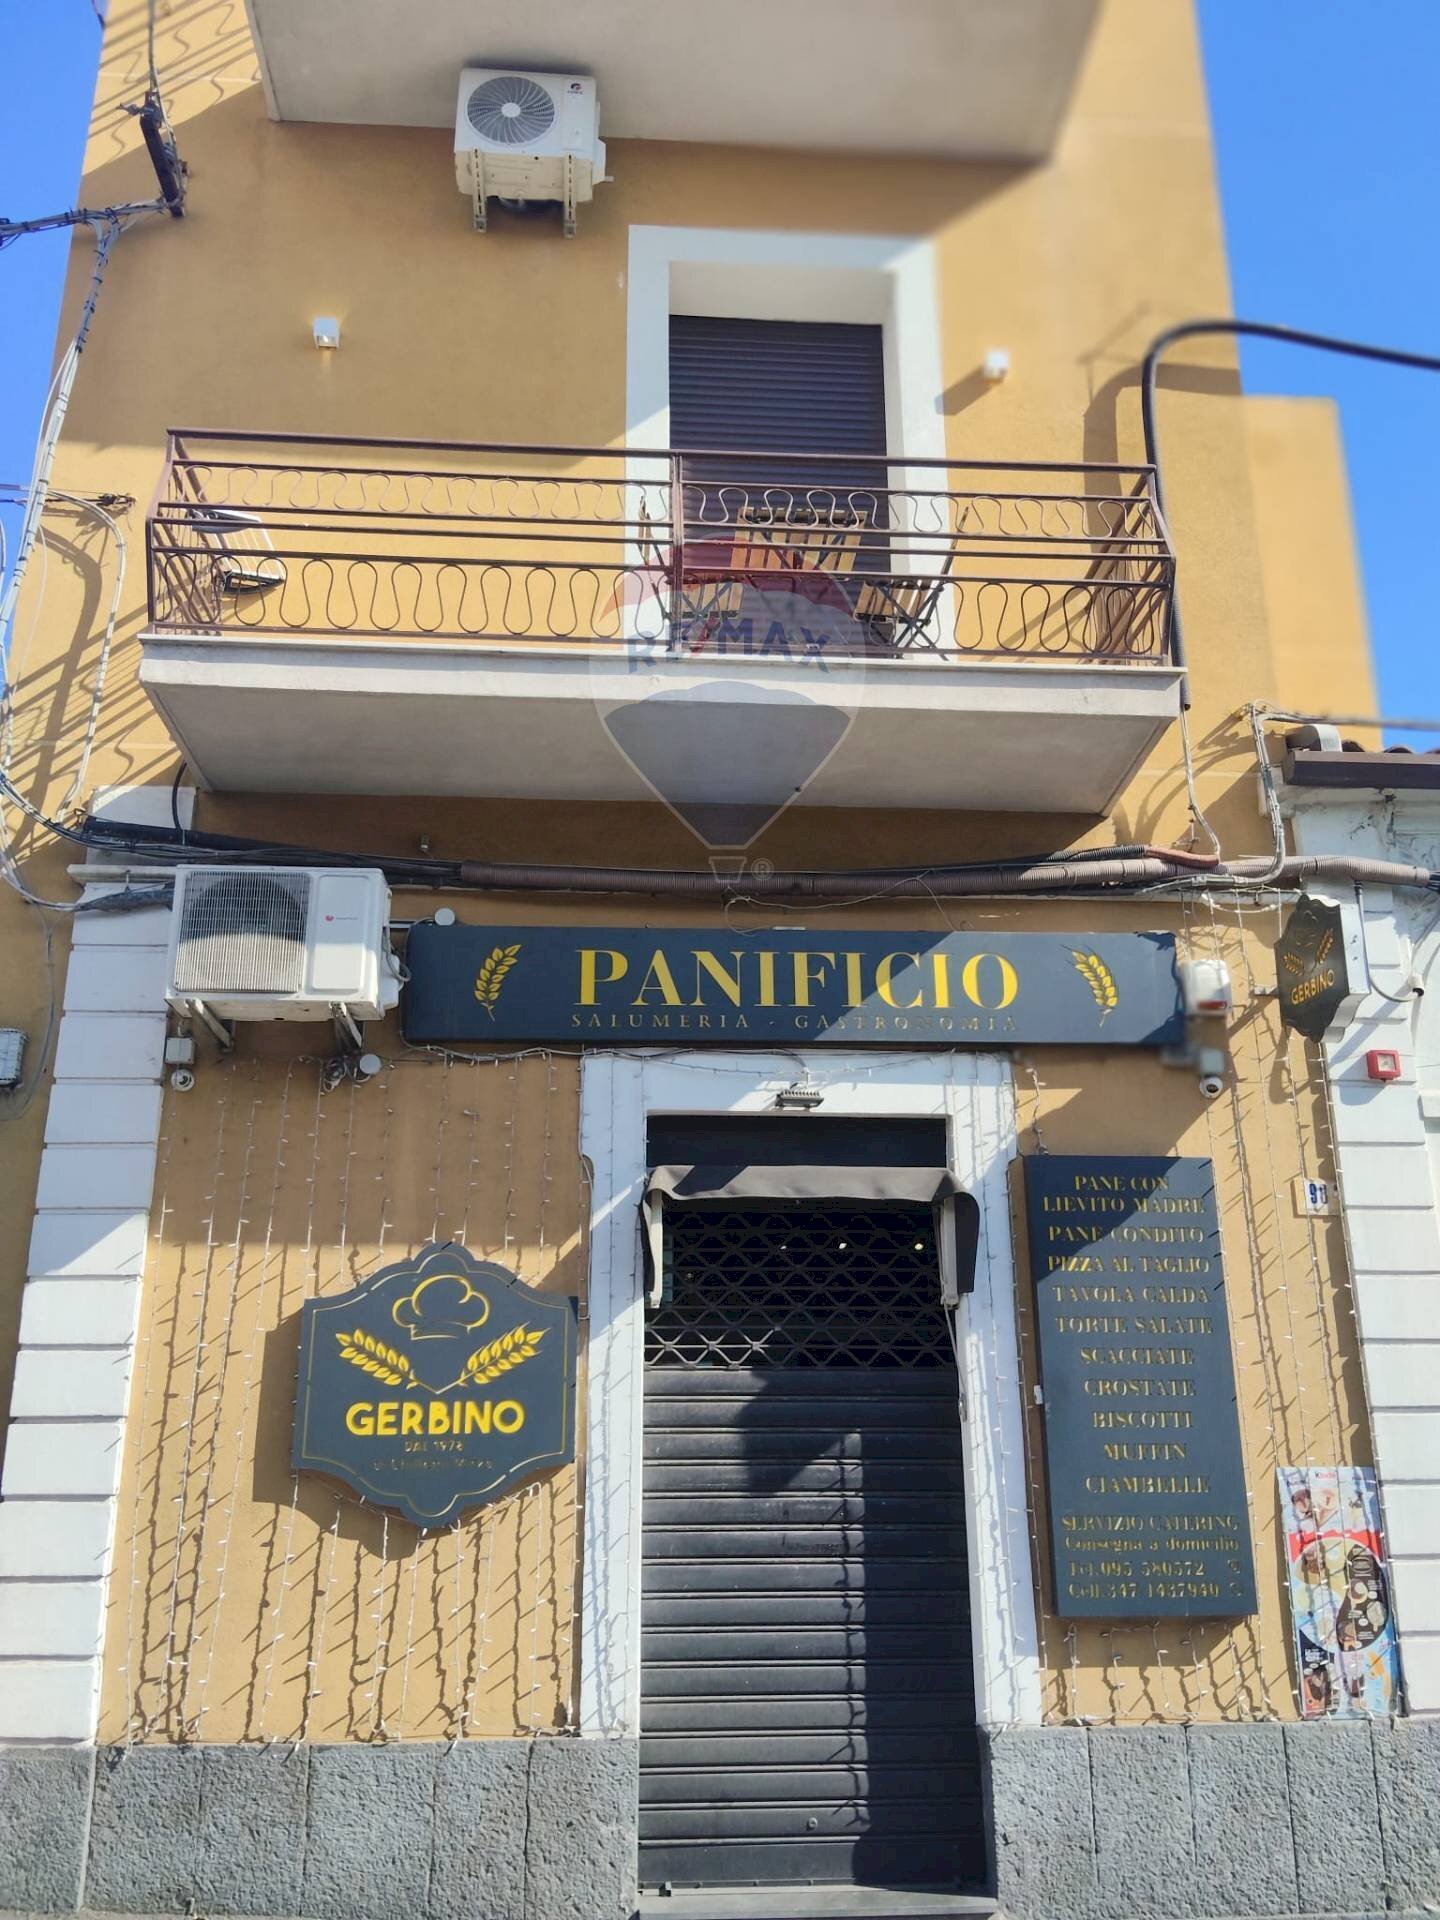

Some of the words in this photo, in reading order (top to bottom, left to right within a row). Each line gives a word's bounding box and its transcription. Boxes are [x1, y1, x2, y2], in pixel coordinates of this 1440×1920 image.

[573, 949, 1018, 1010] PANIFICIO
[1291, 969, 1335, 1005] GERBINO
[572, 1013, 750, 1029] SALUMERIA
[795, 1014, 1018, 1031] GASTRONOMIA
[1074, 1176, 1125, 1191] PANE
[1130, 1176, 1169, 1191] CON
[1042, 1197, 1125, 1212] LIEVITO
[1132, 1197, 1206, 1213] MADRE
[1048, 1226, 1103, 1242] PANE
[1110, 1227, 1204, 1243] CONDITO
[1047, 1256, 1104, 1272] PIZZA
[1112, 1256, 1134, 1272] AL
[1139, 1256, 1211, 1273] TAGLIO
[1052, 1287, 1135, 1303] TAVOLA
[1143, 1287, 1211, 1303] CALDA
[1055, 1317, 1127, 1334] TORTE
[1135, 1317, 1213, 1334] SALATE
[1080, 1348, 1194, 1365] SCACCIATE
[1084, 1379, 1196, 1396] CROSTATE
[345, 1400, 525, 1437] GERBINO
[1092, 1411, 1193, 1428] BISCOTTI
[1104, 1443, 1188, 1460] MUFFIN
[1085, 1476, 1210, 1493] CIAMBELLE
[1061, 1514, 1144, 1531] SERVIZIO
[1149, 1514, 1239, 1531] CATERING
[1065, 1537, 1144, 1553] Consegna
[1149, 1540, 1159, 1551] a
[1166, 1537, 1240, 1552] domicilio
